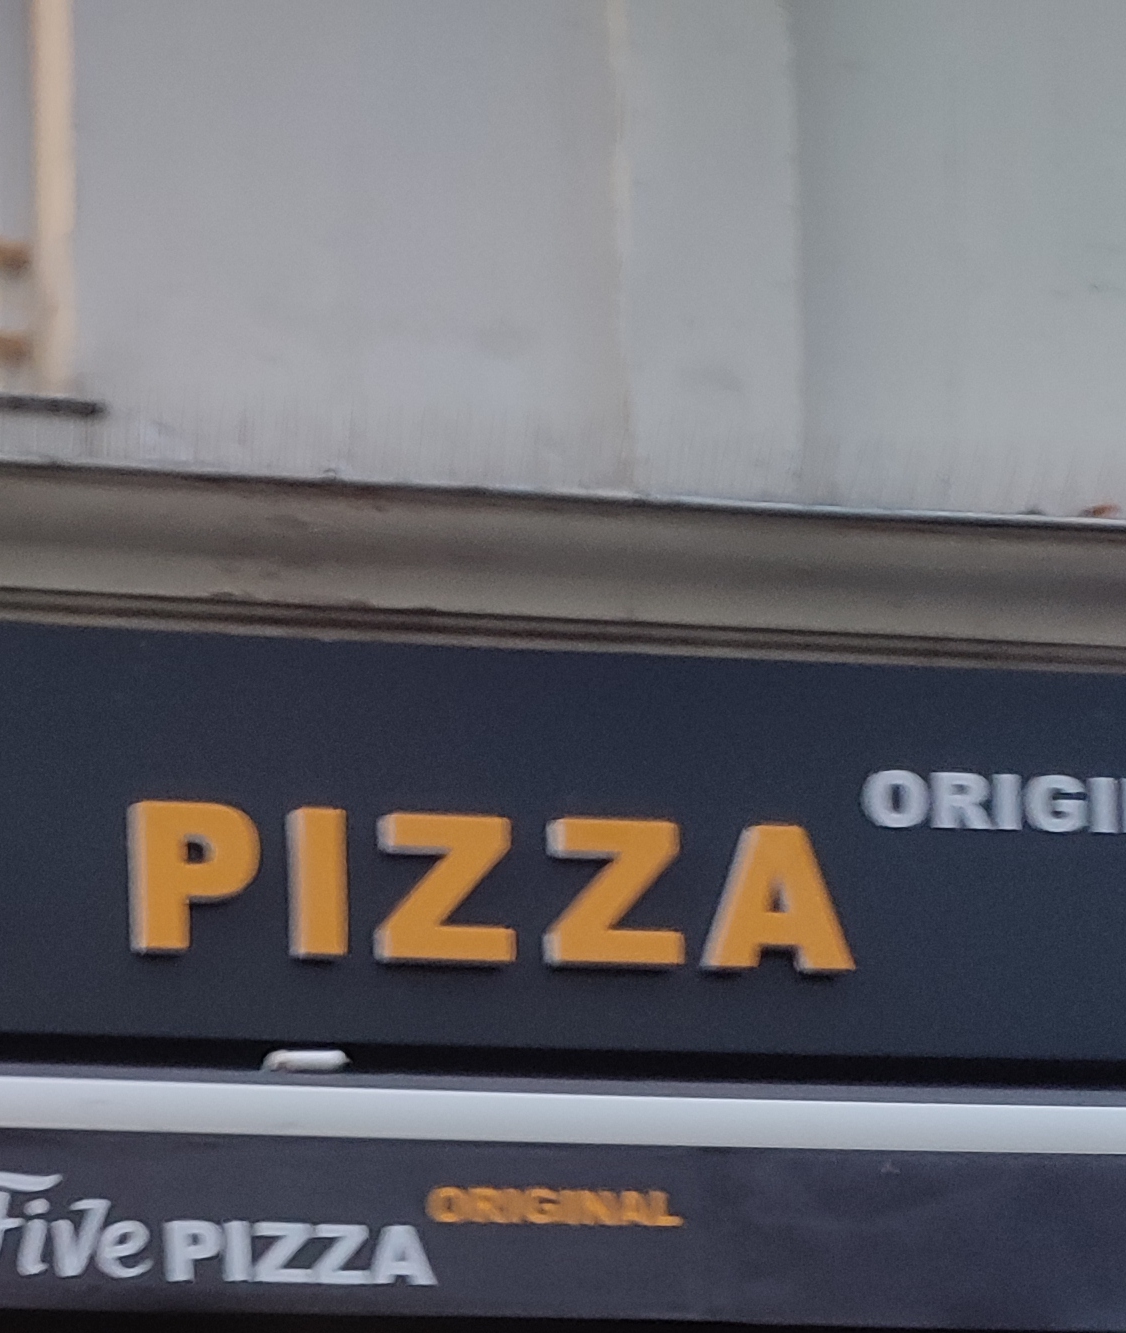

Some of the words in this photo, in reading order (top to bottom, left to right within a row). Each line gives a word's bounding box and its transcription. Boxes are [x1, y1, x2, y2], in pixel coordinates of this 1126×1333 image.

[126, 800, 856, 972] PIZZA
[860, 769, 1126, 834] ORIGI
[164, 1217, 438, 1286] PIZZA
[425, 1185, 685, 1228] ORIGINAL
